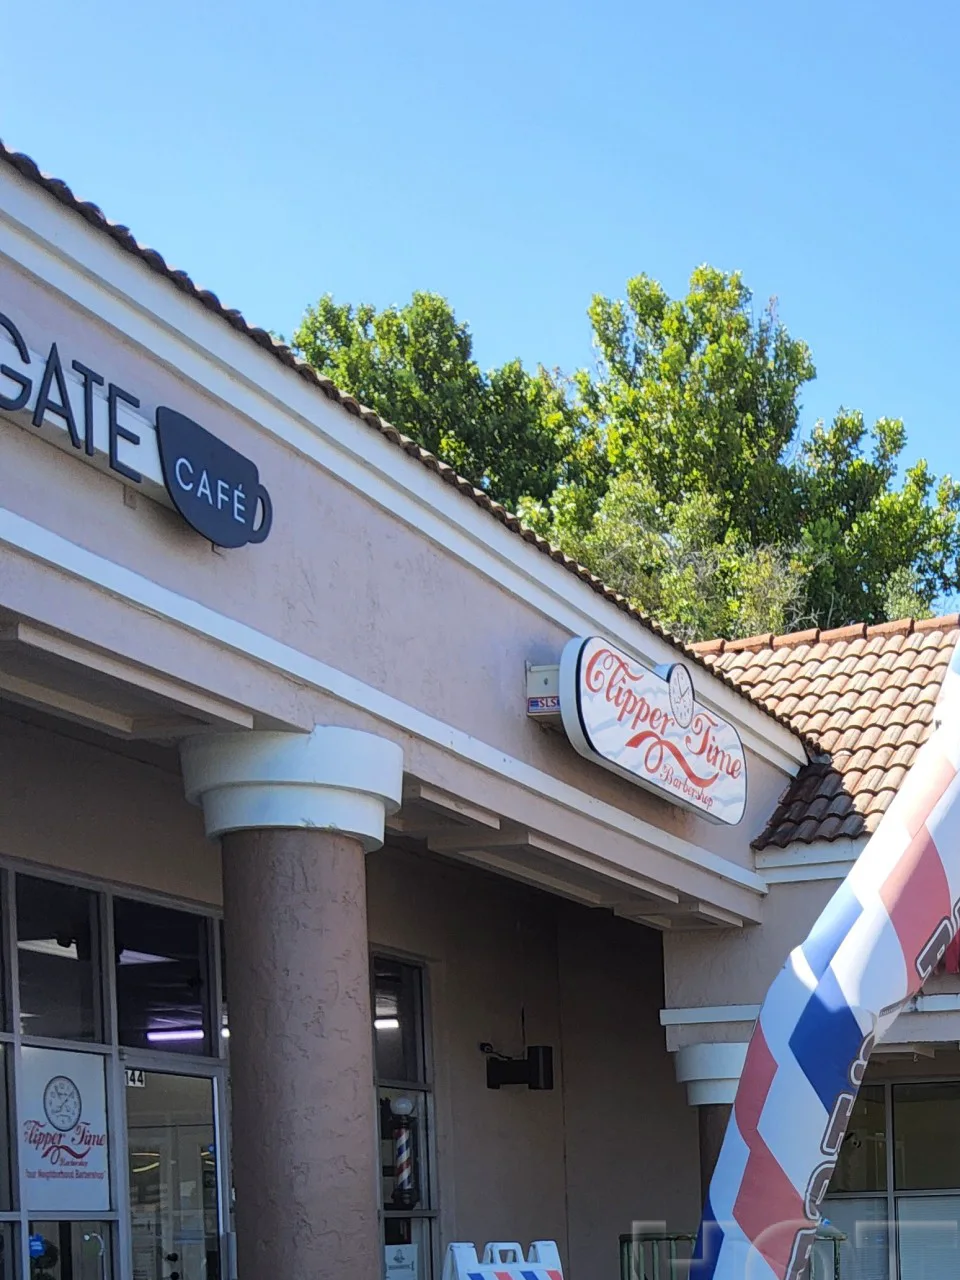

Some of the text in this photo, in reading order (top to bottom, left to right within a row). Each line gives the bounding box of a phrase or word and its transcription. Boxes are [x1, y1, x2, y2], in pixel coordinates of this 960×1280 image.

[175, 457, 246, 524] CAFÉ
[585, 648, 742, 779] Clipper Time
[125, 1070, 144, 1086] 144
